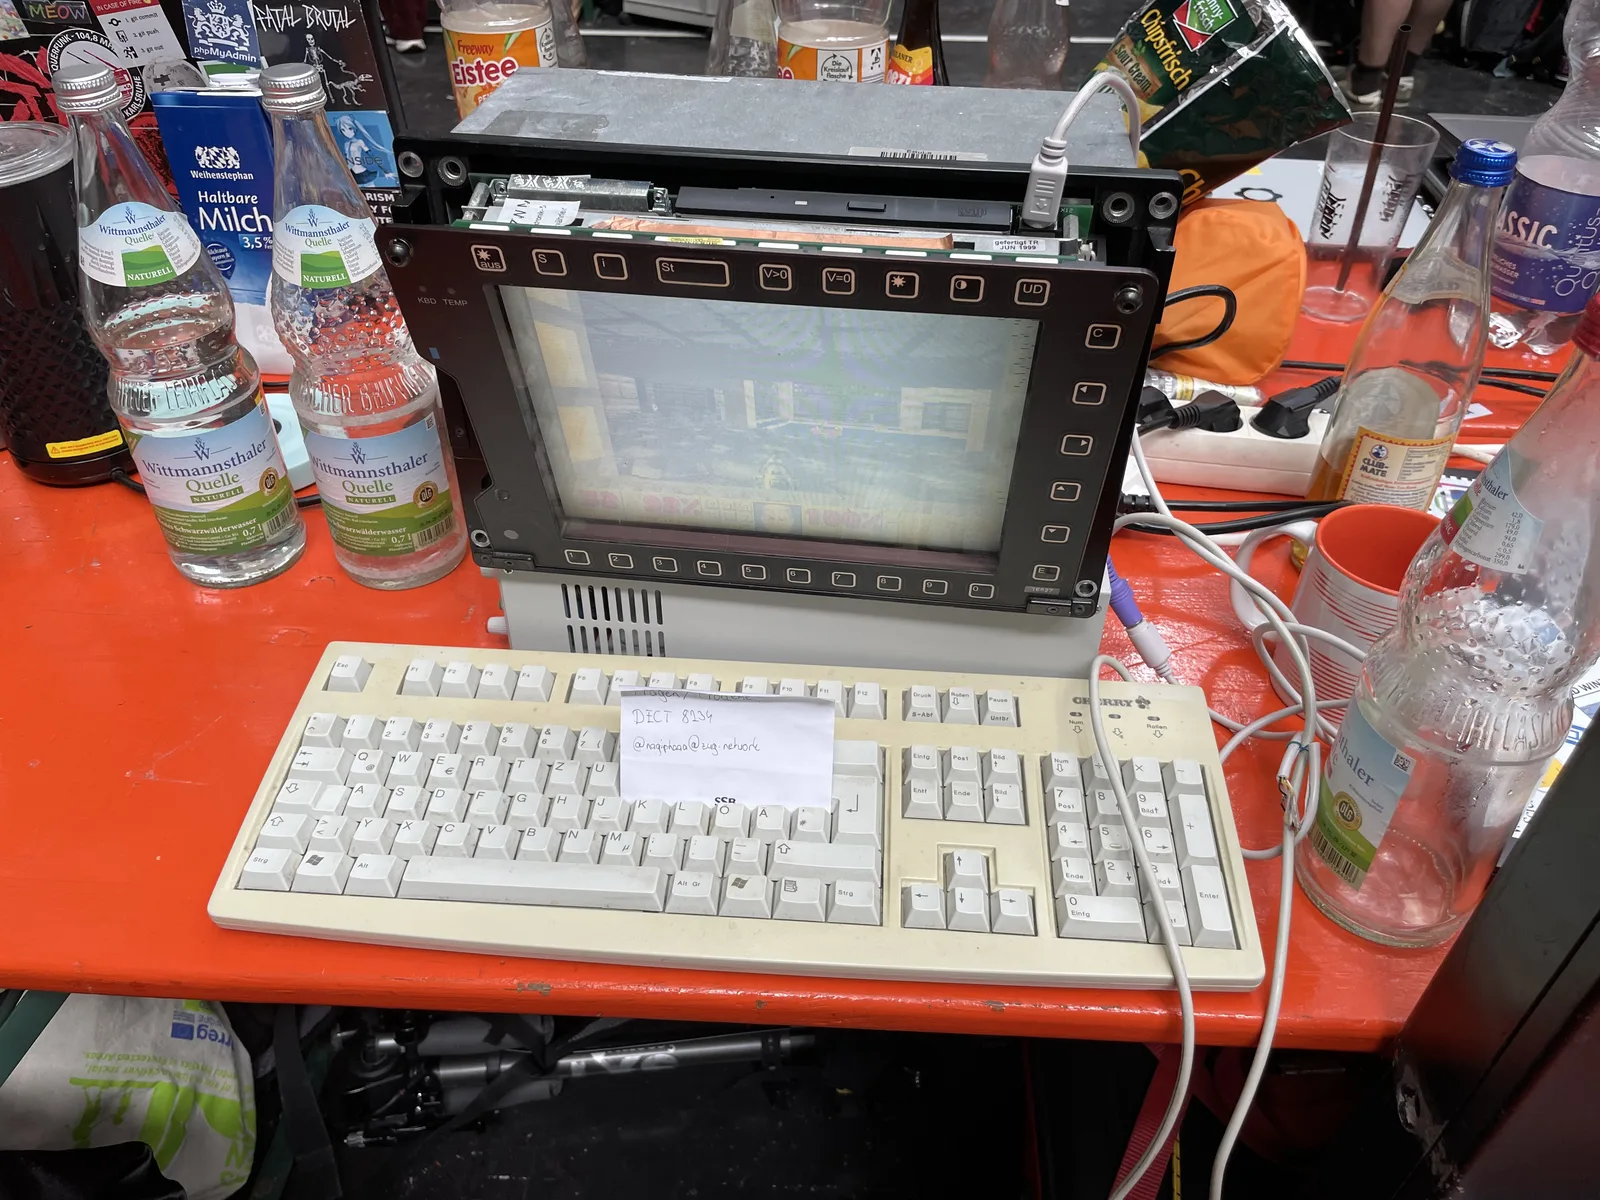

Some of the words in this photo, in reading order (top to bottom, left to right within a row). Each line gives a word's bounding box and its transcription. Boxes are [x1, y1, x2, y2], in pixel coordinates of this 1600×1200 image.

[29, 4, 85, 19] MEOW
[103, 3, 119, 11] CASE
[253, 5, 302, 33] FATAL
[302, 4, 357, 33] BRUTAL
[146, 28, 160, 37] push
[51, 34, 72, 71] QUERFUNK
[76, 32, 98, 42] 104,8
[457, 40, 494, 56] Freeway
[1141, 9, 1193, 91] Chipsfrisch
[194, 46, 257, 63] phpMyAdmin
[1115, 44, 1133, 67] Sour
[452, 58, 517, 85] Eistee
[1128, 62, 1152, 93] Cream
[125, 75, 141, 117] KARLSRUHE
[190, 170, 254, 182] Weihenstephan
[198, 190, 259, 205] Haltbare
[366, 192, 395, 203] RISM
[198, 205, 274, 233] Milch
[99, 214, 167, 236] Wittmannsthaler
[285, 221, 351, 238] Wittmannsthaler
[124, 232, 153, 247] Quelle
[242, 236, 263, 249] 3,5
[305, 237, 332, 248] Quelle
[538, 254, 547, 264] S
[480, 260, 502, 270] aus
[661, 262, 675, 273] St
[127, 266, 173, 281] NATURELL
[303, 273, 348, 283] NATURELL
[764, 268, 787, 281] V>0
[827, 272, 851, 284] V=0
[1022, 283, 1043, 295] UD
[417, 297, 437, 306] KBD
[442, 298, 468, 307] TEMP
[1092, 328, 1103, 338] C
[142, 438, 268, 478] Wittmannsthaler
[310, 453, 429, 479] Wittmannsthaler
[1362, 457, 1389, 470] CLUB-
[1360, 465, 1387, 477] MATE
[186, 472, 240, 494] Quelle
[342, 479, 394, 495] Quelle
[193, 488, 242, 503] NATURELL
[348, 496, 395, 505] NATURELL
[421, 490, 433, 501] DLG
[242, 526, 257, 538] 0,7
[391, 533, 406, 544] 0,7
[1072, 696, 1133, 707] CHRRY
[632, 708, 673, 724] DECT
[358, 752, 369, 762] Q
[398, 754, 411, 763] W
[437, 756, 445, 765] E
[476, 758, 485, 766] R
[517, 760, 526, 768] T
[555, 762, 564, 770] Z
[595, 764, 604, 772] U
[445, 767, 454, 775] €
[354, 786, 364, 794] A
[396, 788, 405, 796] S
[435, 789, 445, 798] D
[476, 791, 485, 799] F
[1057, 789, 1063, 797] 7
[517, 794, 526, 803] G
[557, 796, 567, 804] H
[1098, 792, 1105, 800] 8
[1139, 794, 1147, 802] 9
[597, 798, 605, 806] J
[638, 800, 647, 809] K
[678, 801, 685, 811] L
[1340, 802, 1354, 820] DLG
[364, 819, 372, 827] Y
[403, 822, 413, 830] X
[445, 824, 454, 832] C
[488, 826, 496, 834] V
[527, 828, 536, 836] B
[1060, 825, 1067, 833] 4
[1102, 827, 1109, 835] 5
[1145, 830, 1152, 838] 6
[568, 830, 579, 839] N
[610, 832, 621, 841] M
[253, 856, 268, 864] Strg
[1063, 859, 1069, 867] 1
[1108, 862, 1115, 870] 2
[838, 889, 853, 897] Strg
[1070, 897, 1077, 905] 0
[1071, 910, 1090, 918] Einfg
